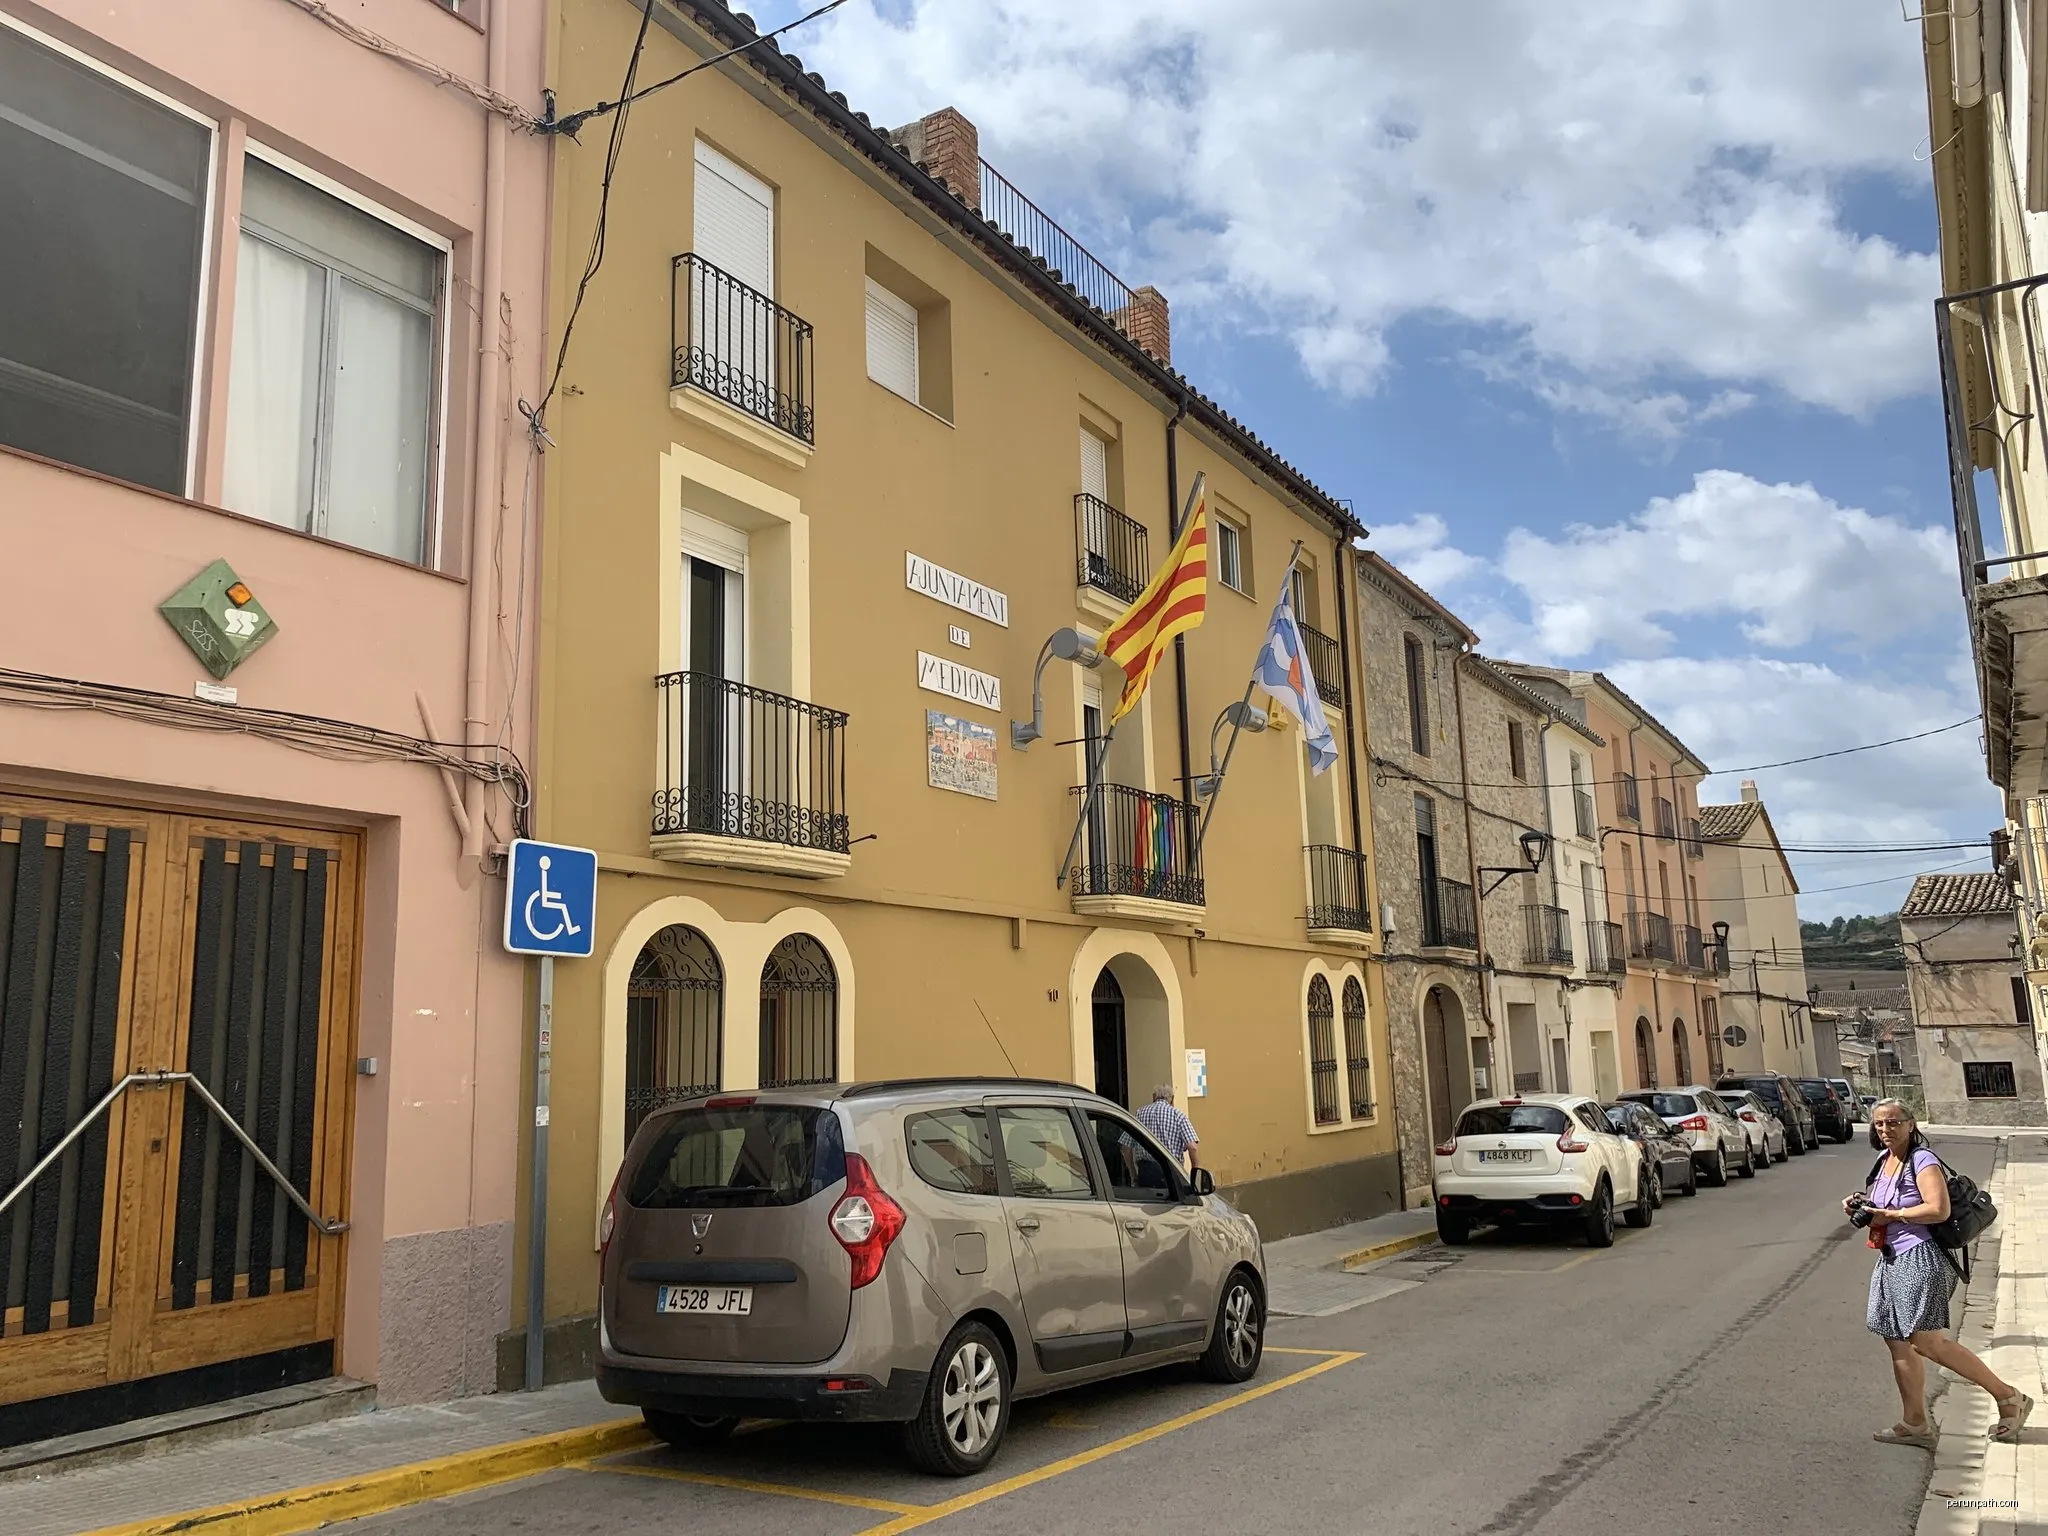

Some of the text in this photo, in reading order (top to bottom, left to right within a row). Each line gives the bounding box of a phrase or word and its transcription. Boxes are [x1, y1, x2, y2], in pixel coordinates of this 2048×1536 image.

[908, 558, 1007, 623] AJUNTAMENT
[951, 626, 969, 645] DE
[919, 657, 1001, 708] MEDIONA
[1048, 989, 1059, 1002] 10
[1486, 1151, 1528, 1160] 4848 KLF
[669, 1288, 748, 1311] 4528 JFL
